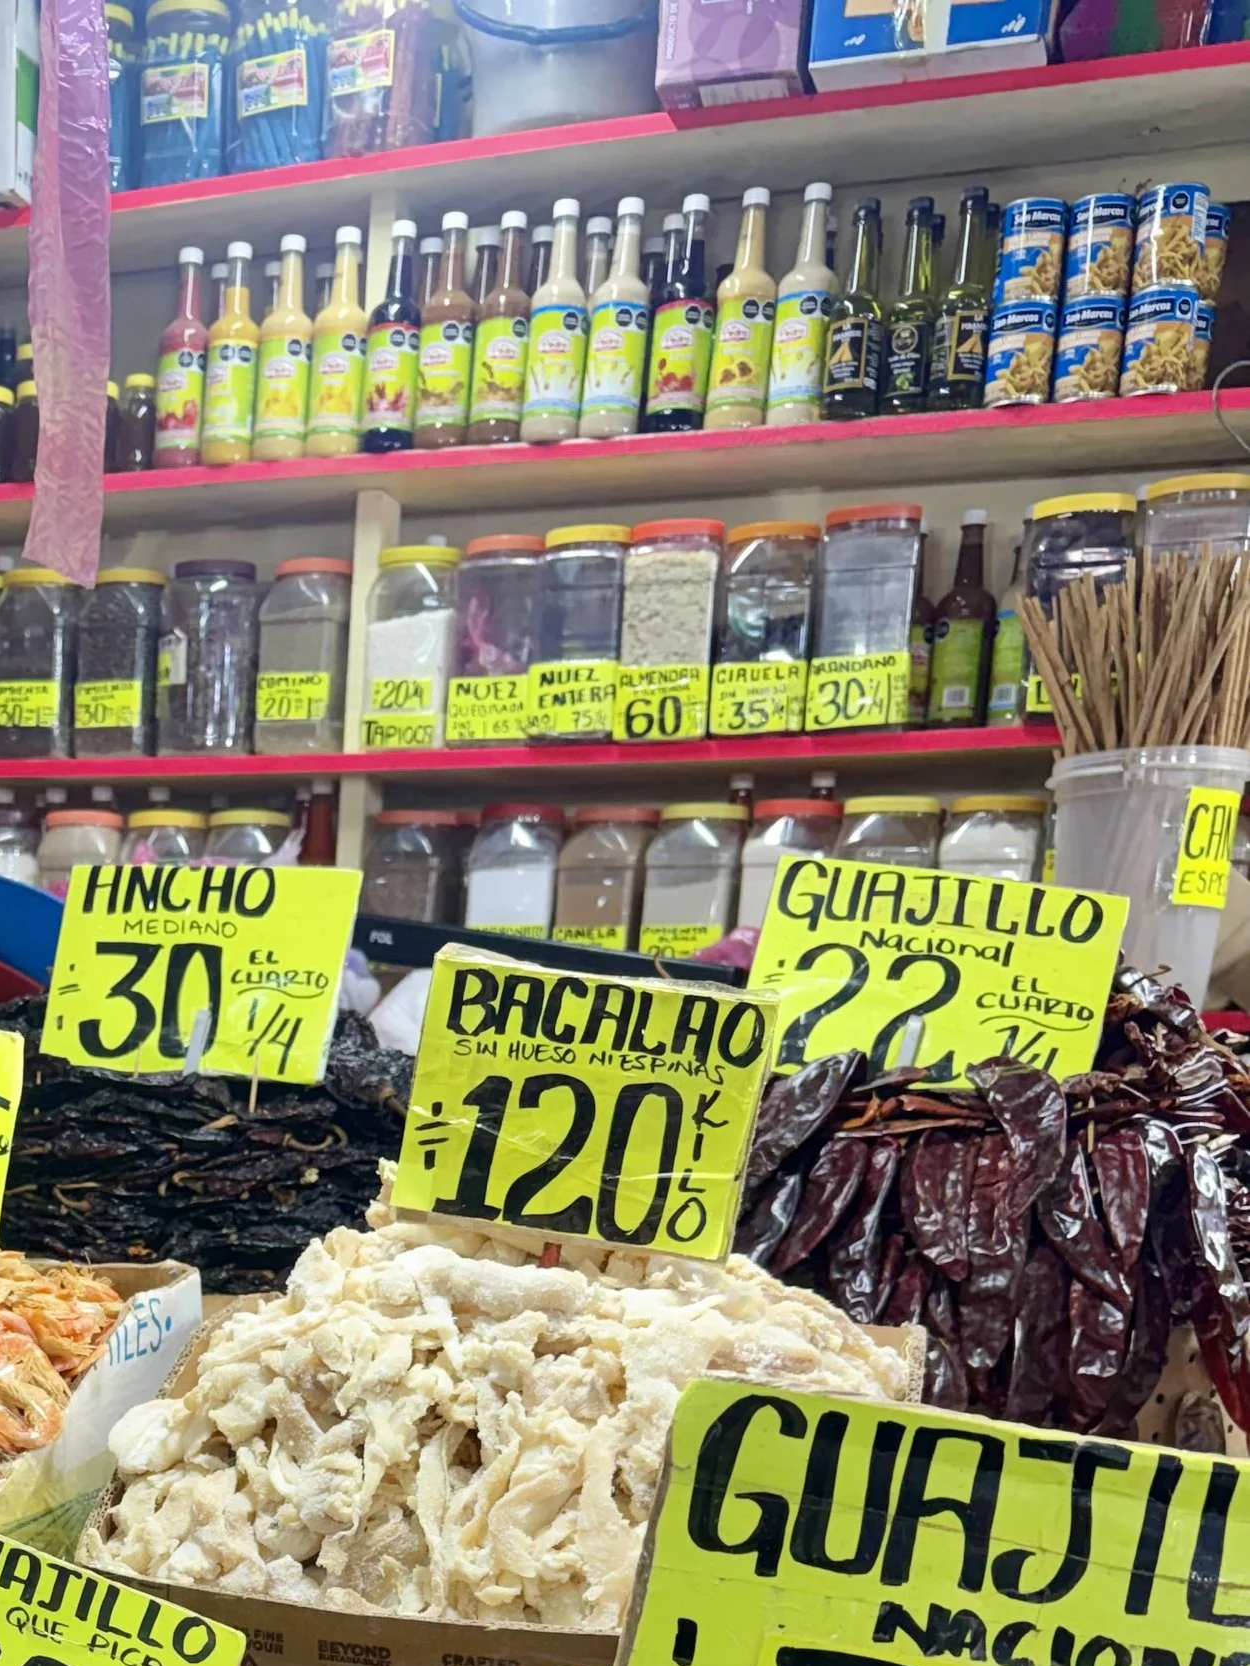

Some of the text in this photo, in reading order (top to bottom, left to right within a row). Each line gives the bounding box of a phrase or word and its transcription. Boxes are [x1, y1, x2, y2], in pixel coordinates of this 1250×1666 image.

[1031, 209, 1062, 222] Marcos
[1092, 204, 1125, 217] Marcos
[1064, 308, 1114, 324] San Marcos
[1140, 301, 1172, 315] Marcos
[993, 312, 1040, 329] San Marcos
[715, 665, 800, 686] CIRUELA
[809, 655, 897, 676] ARANDANO
[257, 675, 323, 690] COMINO
[539, 667, 599, 688] NUEZ
[619, 667, 700, 688] ALMENDRA
[455, 681, 518, 700] NUEZ
[537, 684, 617, 710] ENTERA
[812, 677, 866, 727] 30
[263, 694, 293, 719] 20
[623, 695, 683, 739] 60
[727, 700, 769, 730] 35
[364, 719, 435, 746] TAPIOCA
[82, 866, 276, 918] ANCHO
[778, 859, 1104, 944] GUAJILLO
[123, 919, 238, 939] MEDIANO
[554, 926, 618, 941] CANELA
[250, 949, 280, 965] EL
[859, 928, 1014, 968] Nacional
[230, 969, 329, 990] CUARTO
[1011, 975, 1049, 995] EL
[78, 941, 224, 1059] 30
[976, 991, 1095, 1022] CUARTO
[446, 968, 766, 1069] BACALAO
[776, 942, 965, 1084] 22
[247, 998, 304, 1075] 1/4
[453, 1038, 498, 1058] SIN
[507, 1041, 577, 1065] HUESO
[432, 1073, 684, 1246] 120
[665, 1088, 729, 1243] KILO
[6, 1606, 70, 1645] QUE
[254, 1629, 284, 1643] FINE
[317, 1638, 392, 1660] BEYOND
